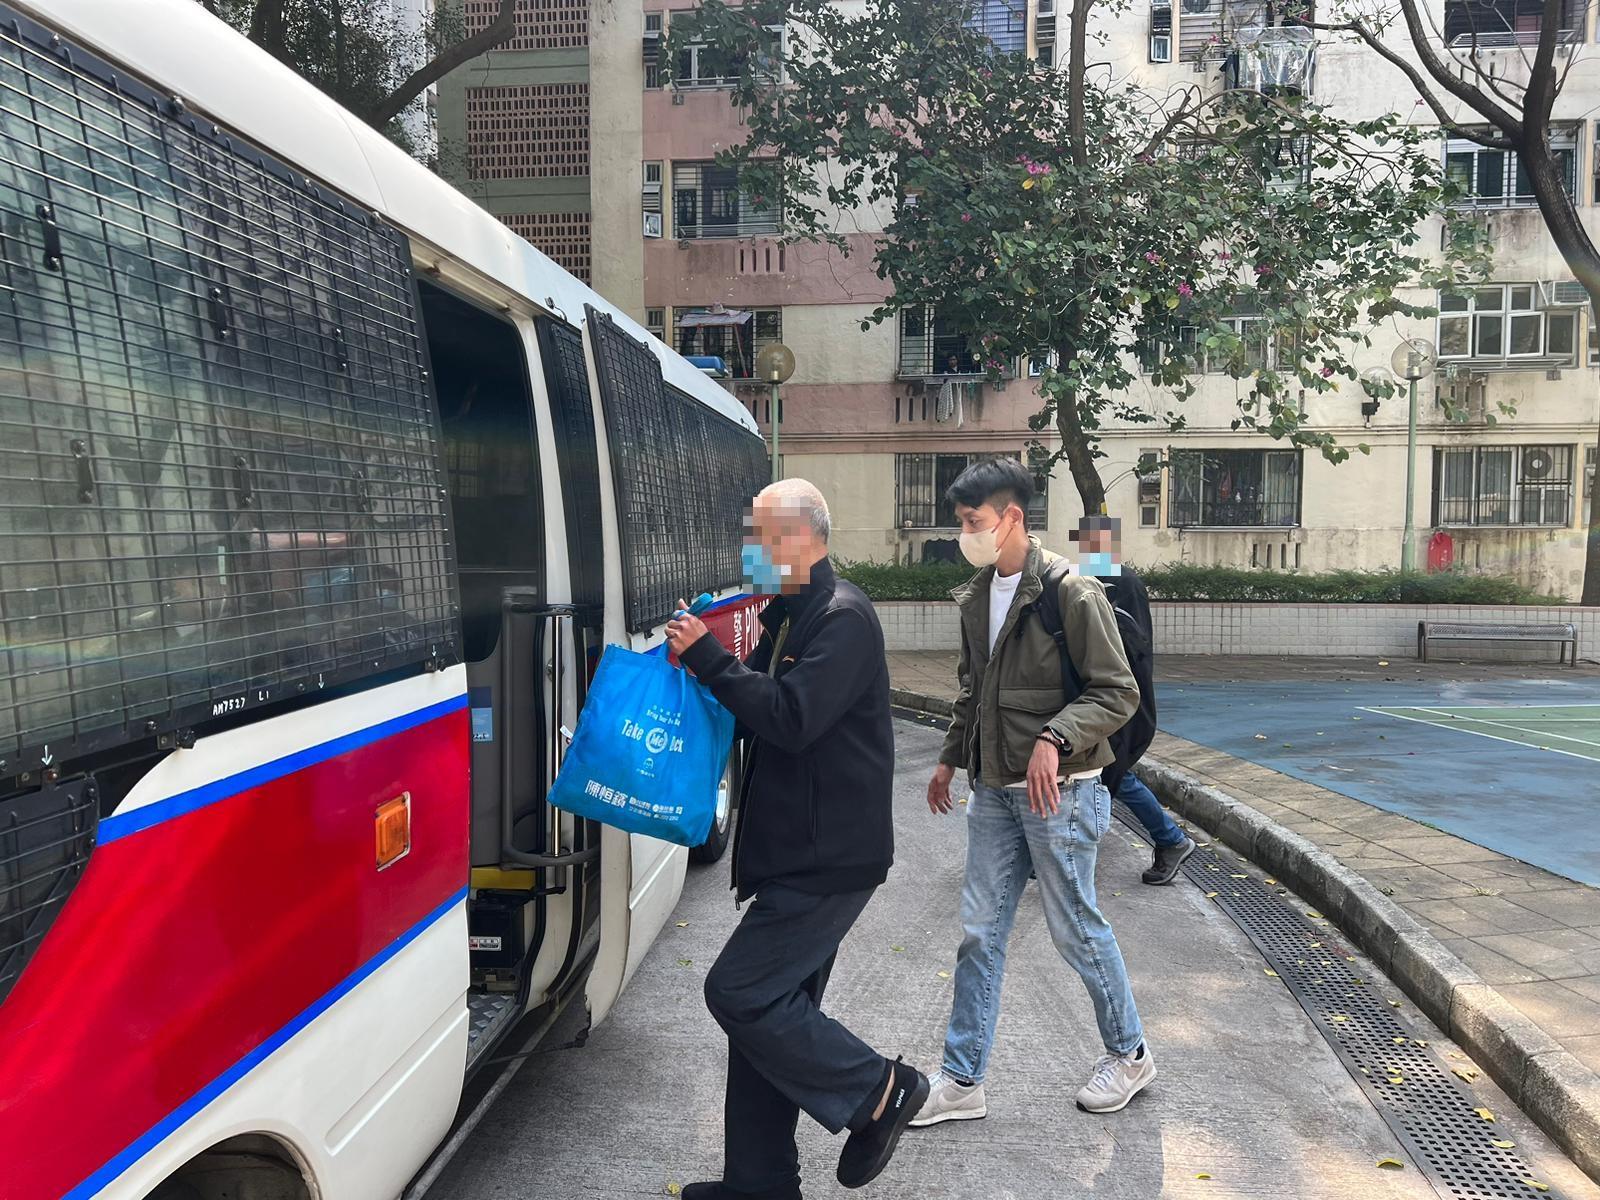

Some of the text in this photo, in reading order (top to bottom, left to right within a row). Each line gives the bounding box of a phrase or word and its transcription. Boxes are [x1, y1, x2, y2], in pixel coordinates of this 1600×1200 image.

[745, 598, 769, 655] POL
[621, 719, 645, 741] Take
[650, 733, 664, 746] Me
